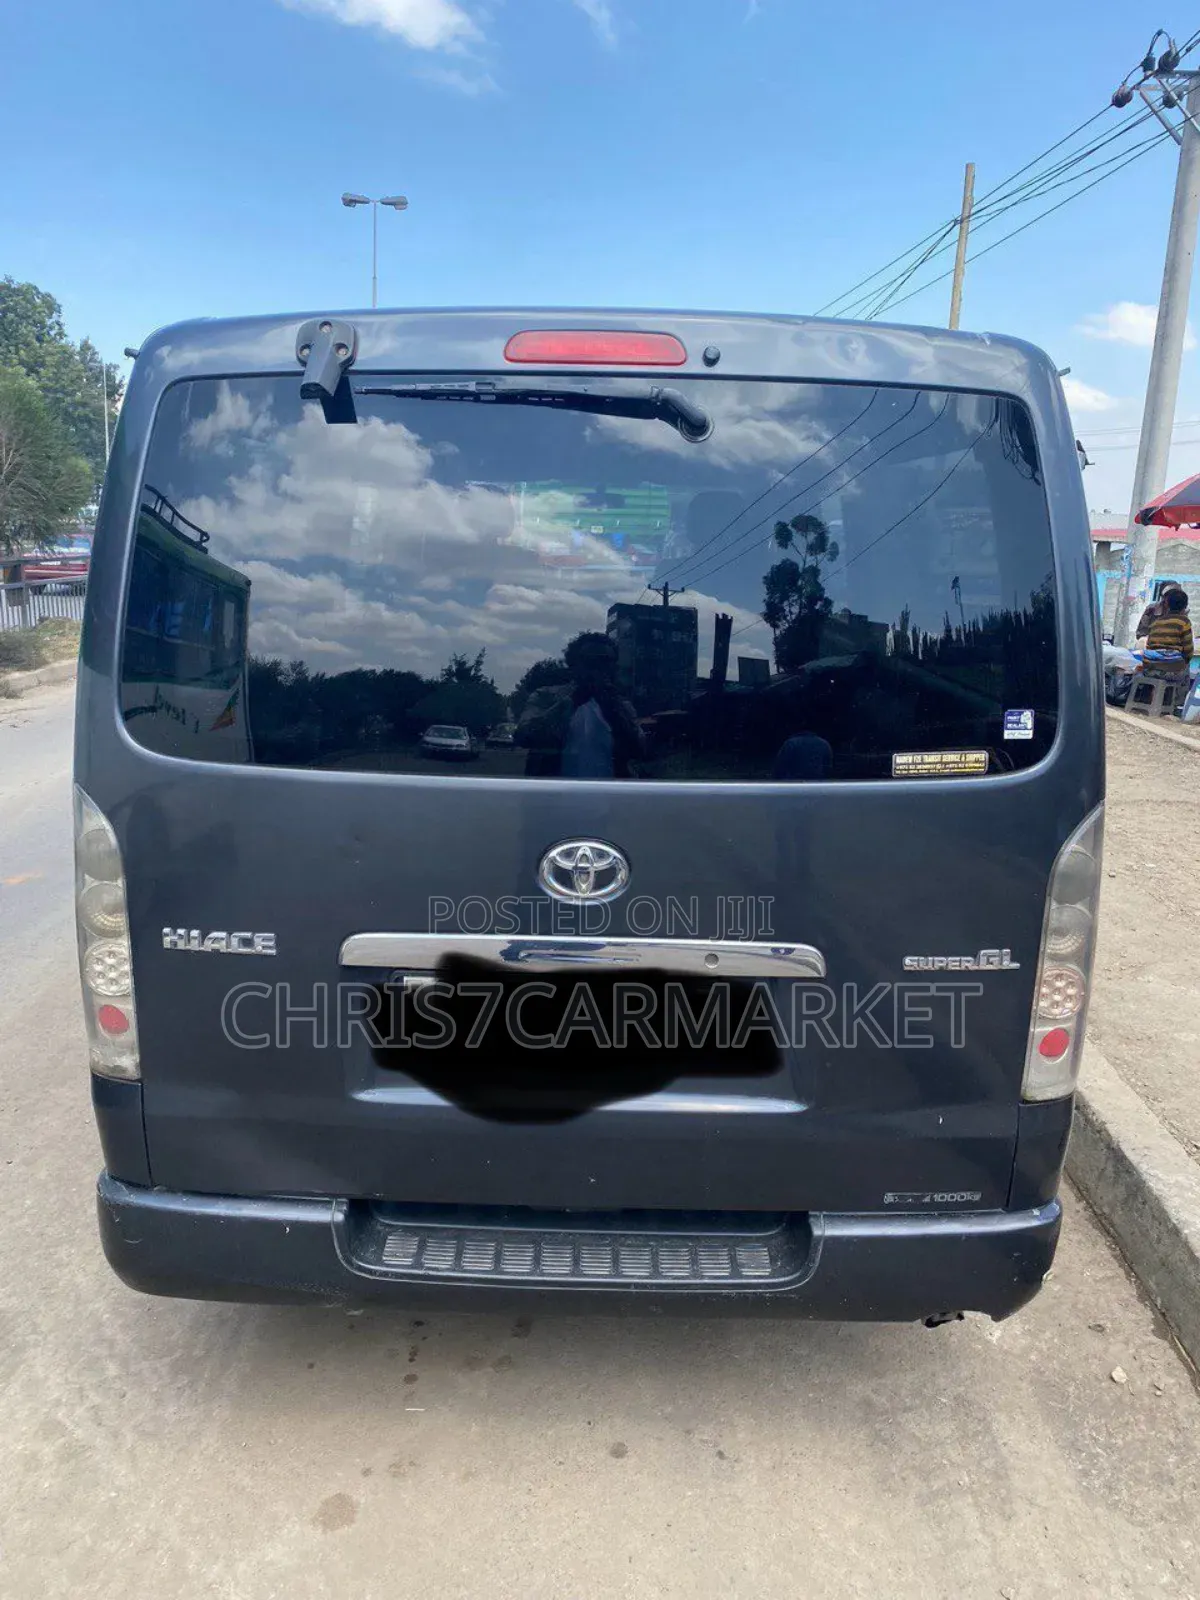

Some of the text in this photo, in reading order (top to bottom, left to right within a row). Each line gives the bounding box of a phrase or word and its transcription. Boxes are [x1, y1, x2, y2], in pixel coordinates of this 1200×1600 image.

[162, 927, 277, 956] HIACE
[902, 948, 1021, 971] SUPER GL
